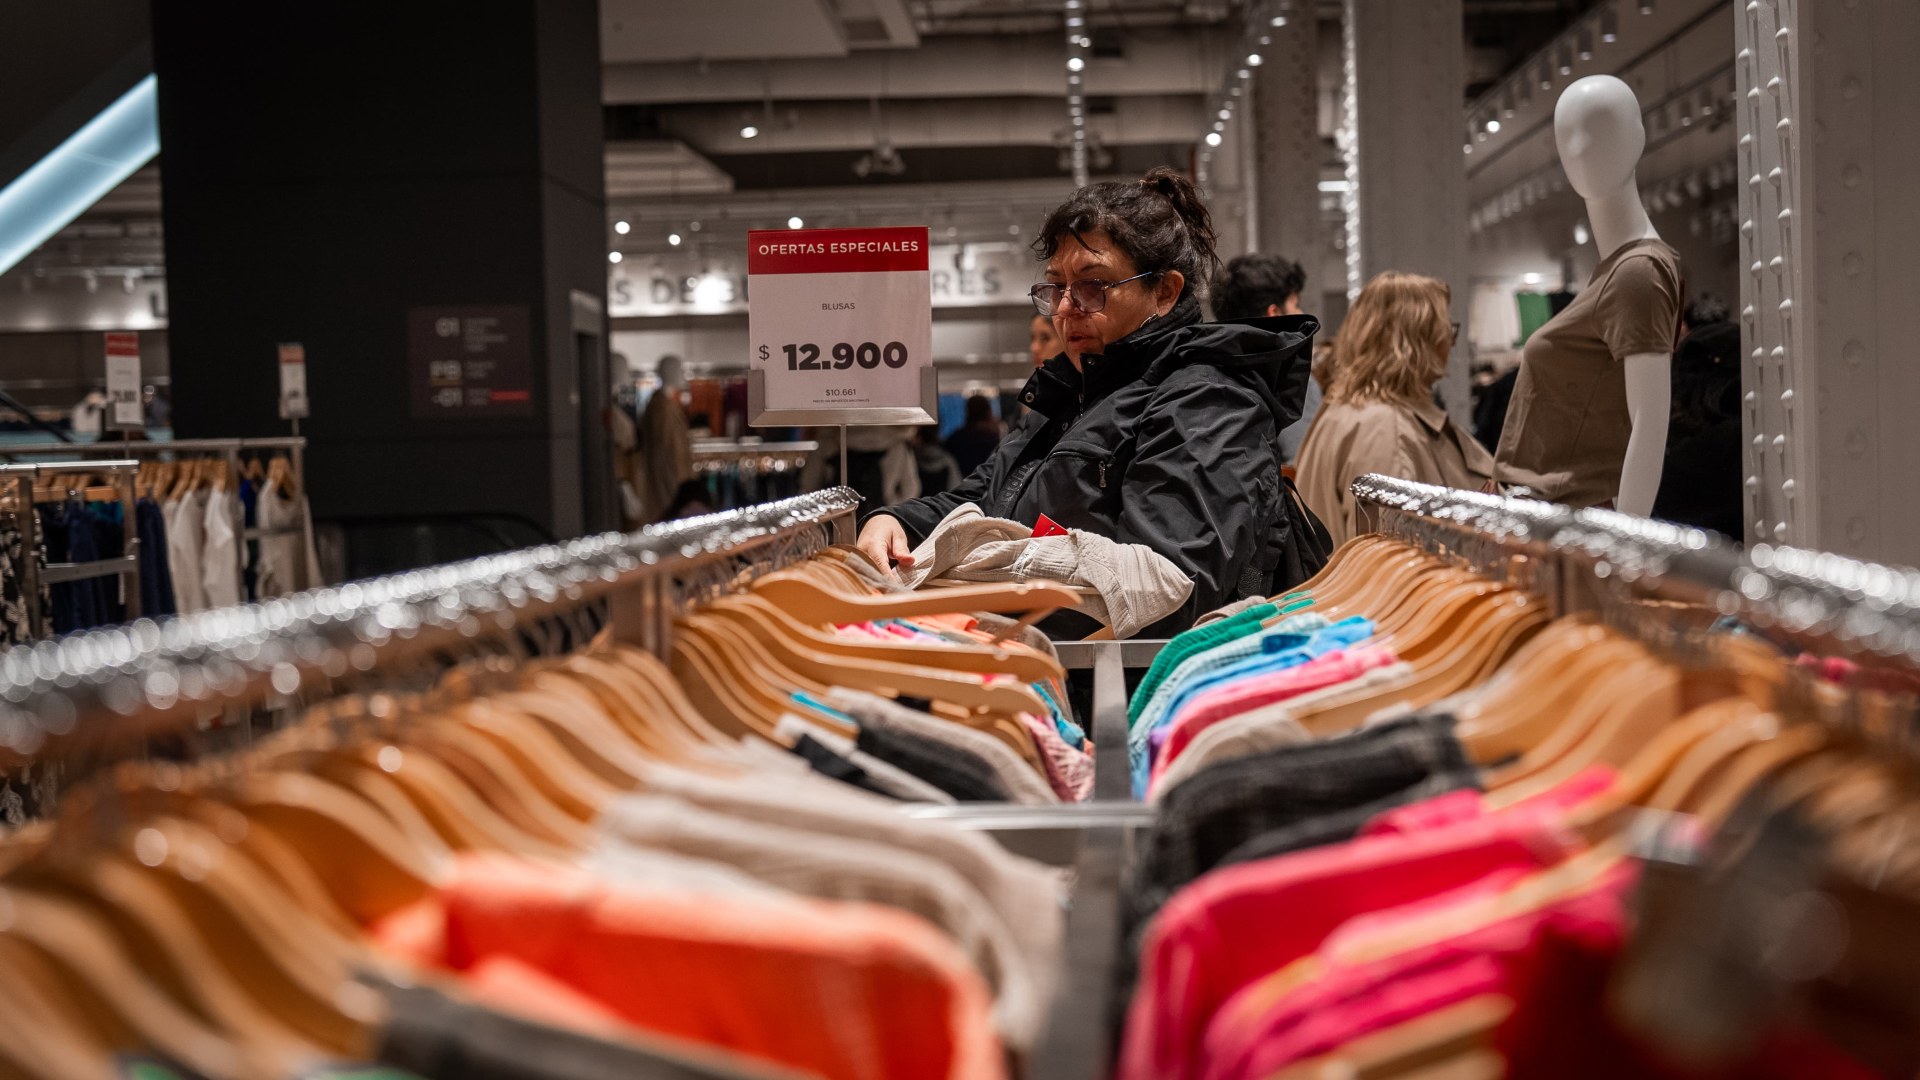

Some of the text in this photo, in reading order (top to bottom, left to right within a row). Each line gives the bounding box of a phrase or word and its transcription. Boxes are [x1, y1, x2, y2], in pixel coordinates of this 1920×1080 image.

[758, 240, 919, 256] OFERTAS ESPECIALES
[931, 267, 1003, 296] RES
[821, 302, 856, 311] BLUSAS
[758, 340, 908, 371] $ 12.900
[825, 388, 857, 397] $10.661
